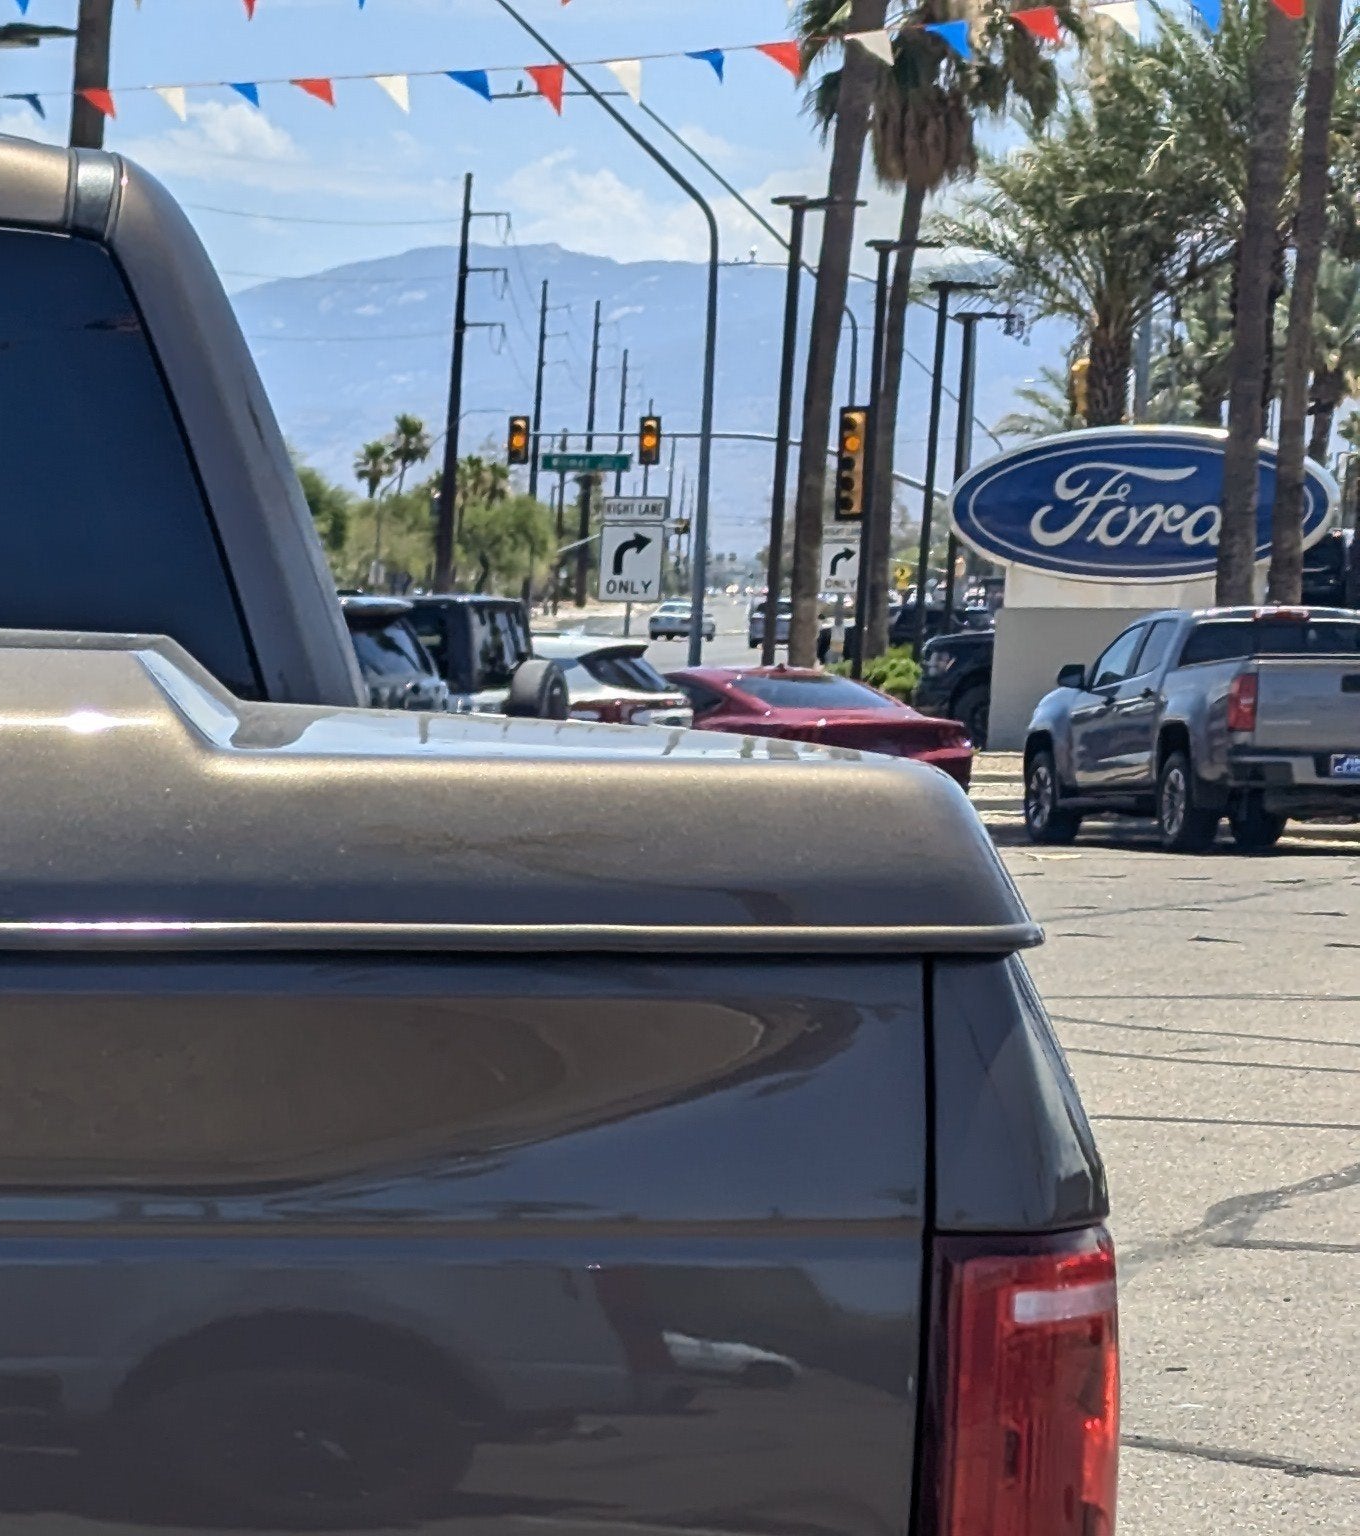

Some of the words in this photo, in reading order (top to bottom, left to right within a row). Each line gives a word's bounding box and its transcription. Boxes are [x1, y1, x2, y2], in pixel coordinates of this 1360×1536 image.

[606, 504, 634, 515] RIGHT
[638, 504, 662, 515] LANE
[605, 580, 652, 594] ONLY
